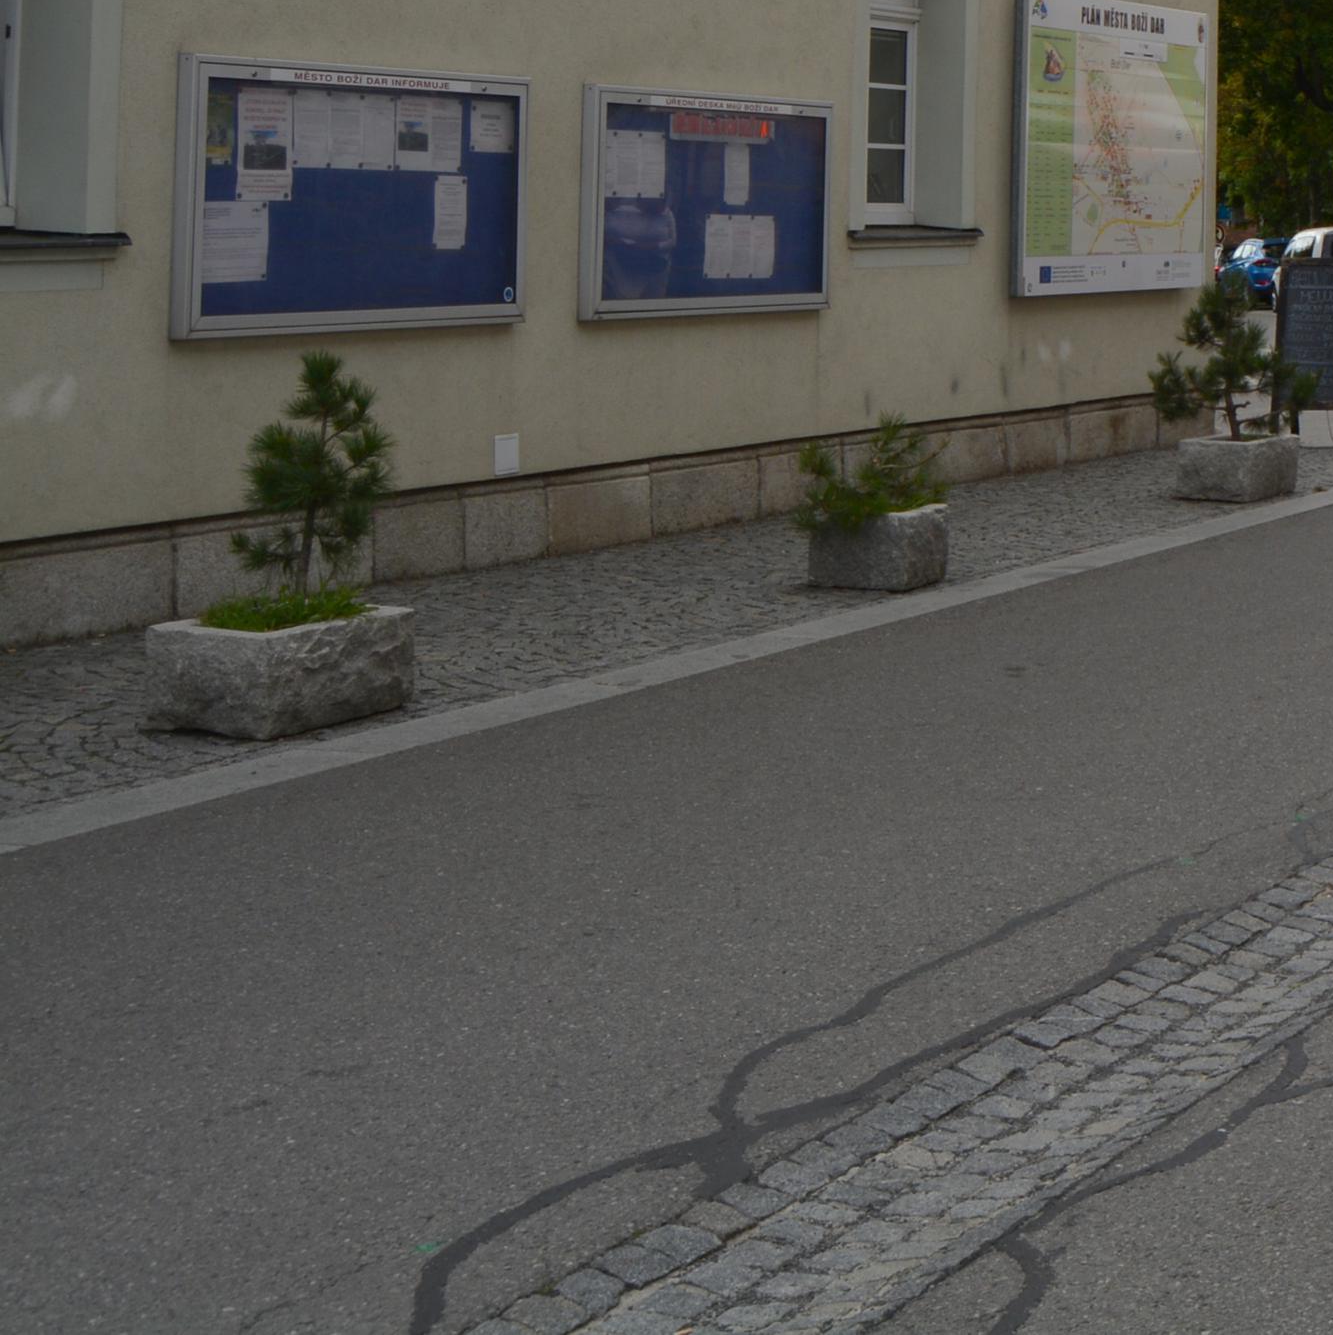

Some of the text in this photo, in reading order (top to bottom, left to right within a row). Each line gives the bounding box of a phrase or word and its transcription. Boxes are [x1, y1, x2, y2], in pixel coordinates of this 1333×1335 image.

[1081, 4, 1165, 35] PLÁN MĚSTA BOŽÍ DAR
[294, 71, 333, 82] MĚSTO
[337, 74, 363, 84] BOŽÍ
[391, 79, 450, 90] INFORMUJE
